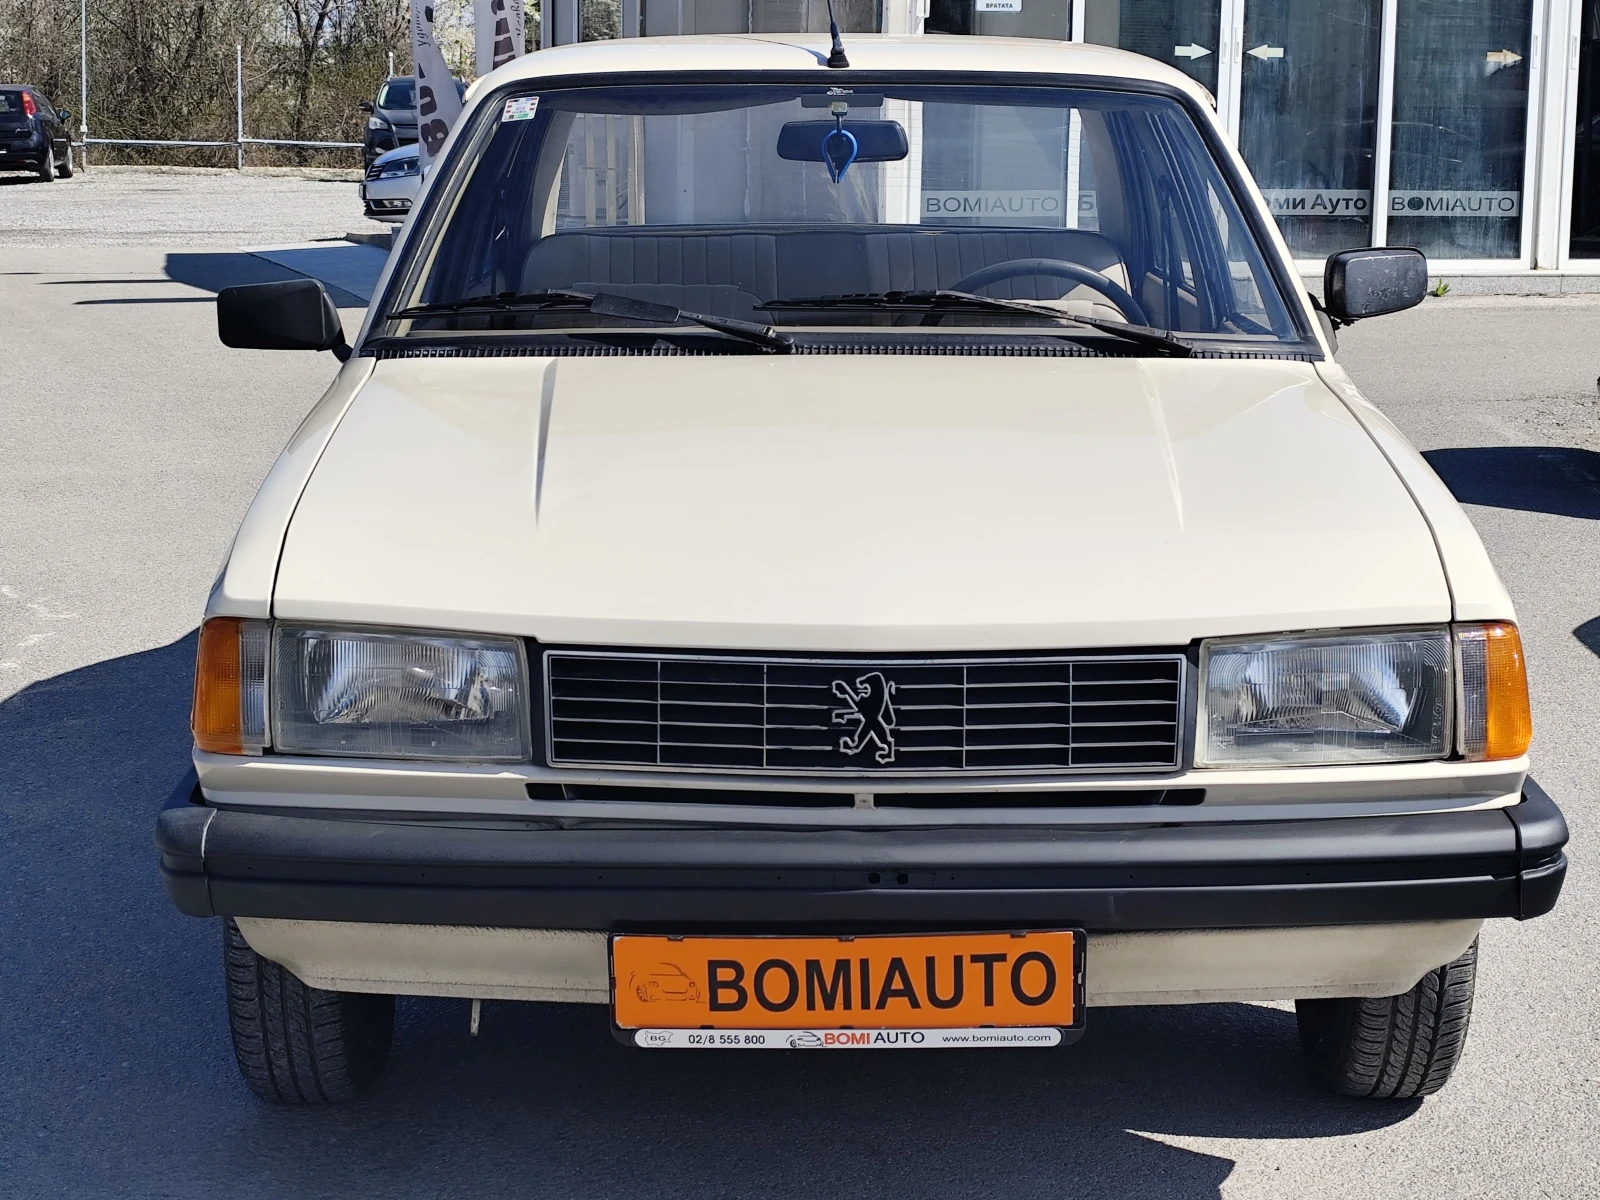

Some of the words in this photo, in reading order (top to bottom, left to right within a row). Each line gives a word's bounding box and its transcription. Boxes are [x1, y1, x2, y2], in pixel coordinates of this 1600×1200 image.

[926, 197, 1059, 212] BOMIAUTO
[1310, 193, 1367, 214] Ауто
[1391, 196, 1515, 212] BOMIAUTO
[706, 950, 1057, 1013] BOMIAUTO
[650, 1034, 666, 1042] BG
[688, 1034, 715, 1045] 02/8
[719, 1035, 740, 1044] 555
[744, 1034, 765, 1044] 800
[824, 1032, 871, 1045] BOMI
[873, 1031, 925, 1044] AUTO
[942, 1034, 1051, 1043] www.bomiauto.com
